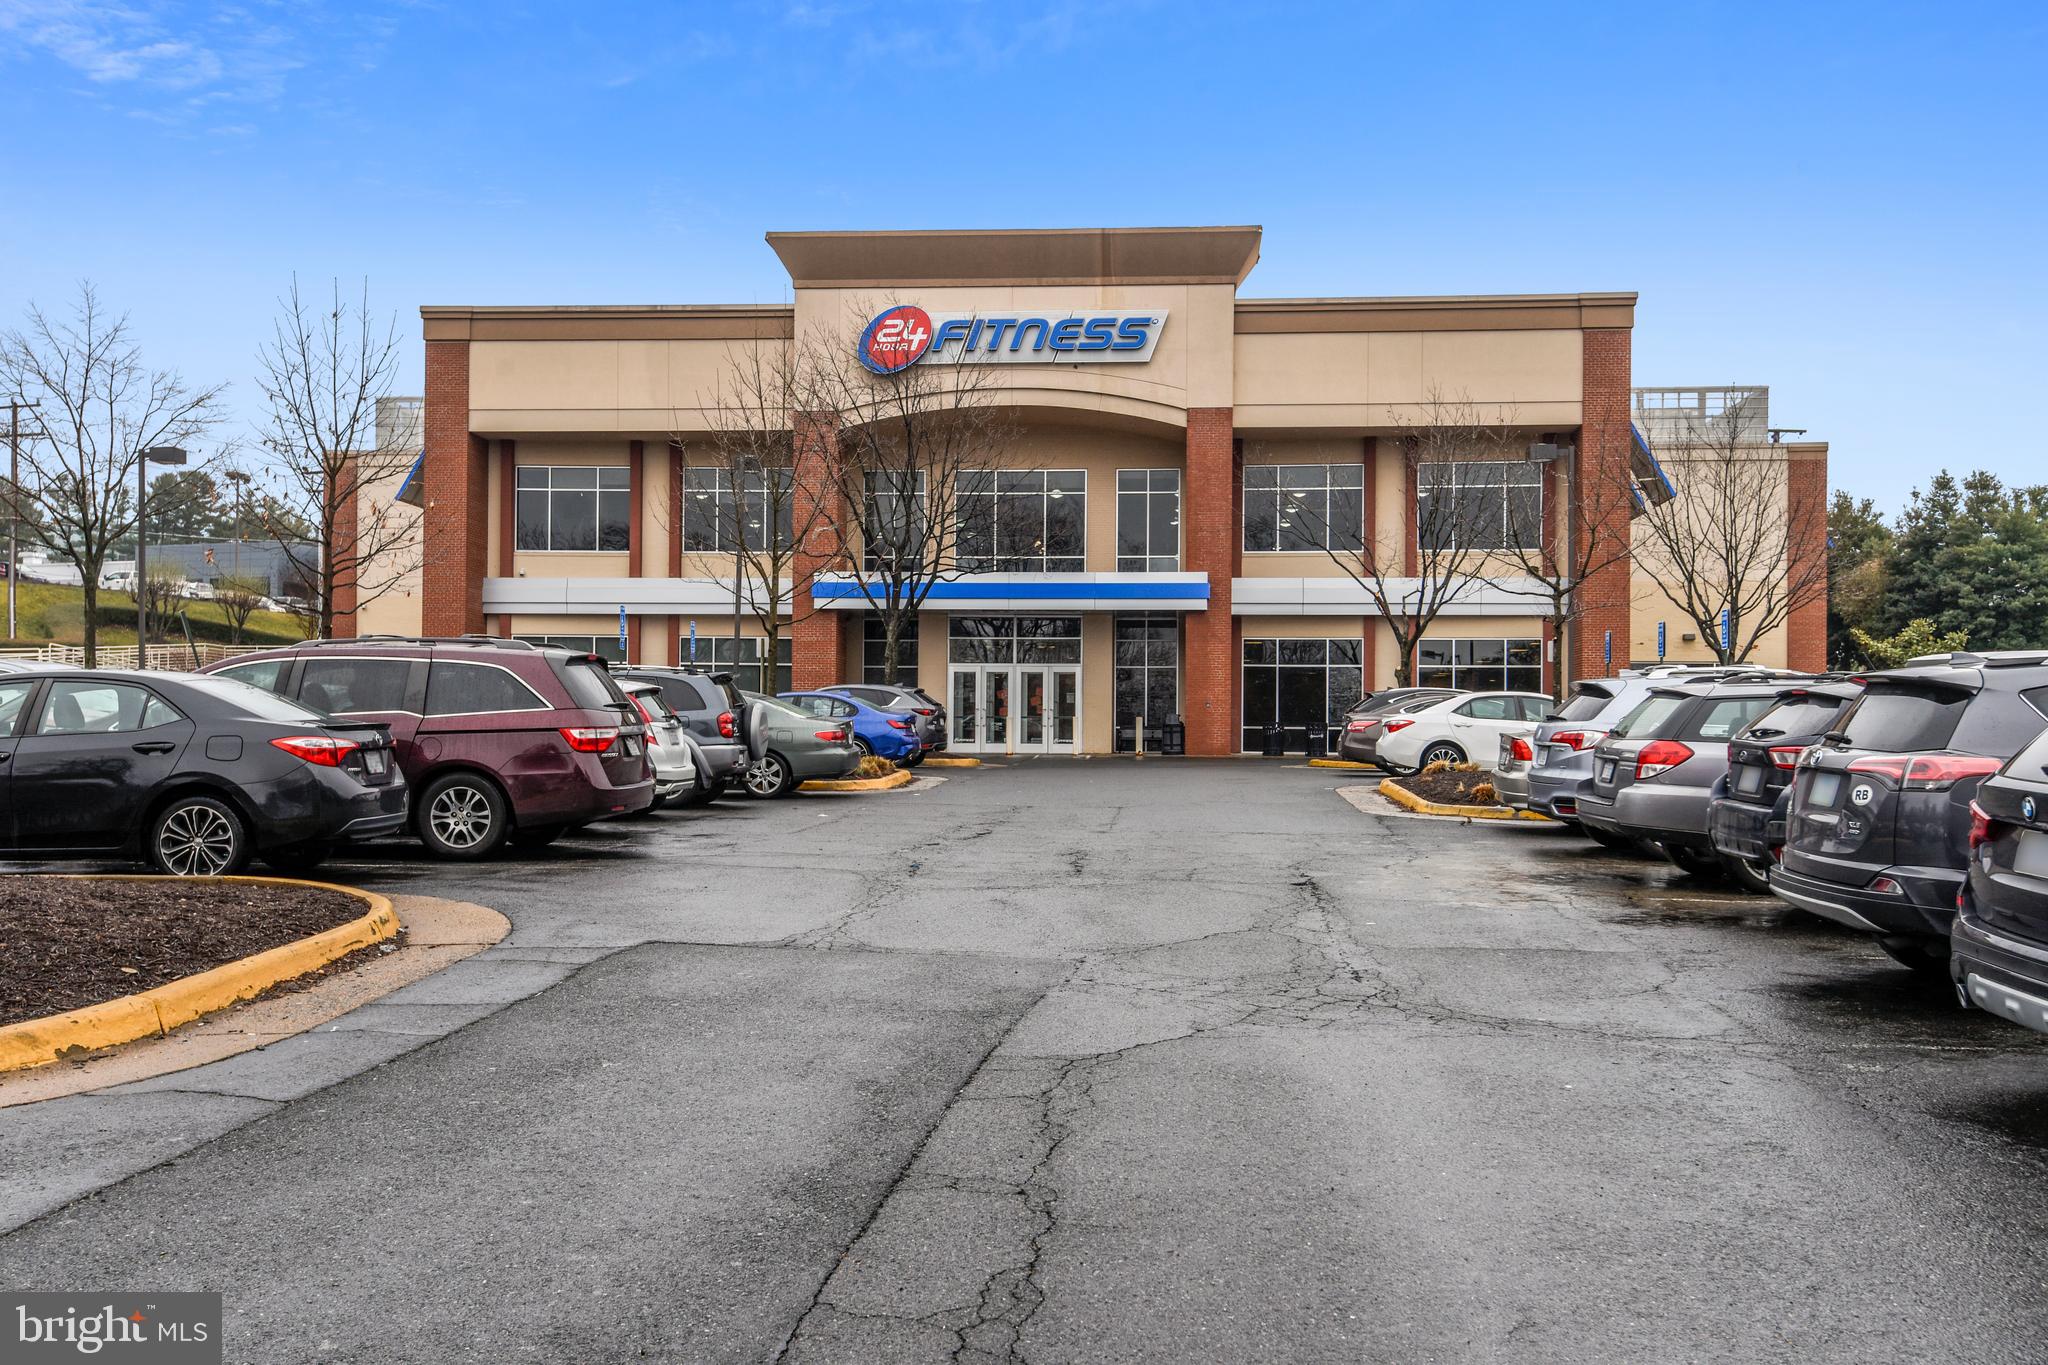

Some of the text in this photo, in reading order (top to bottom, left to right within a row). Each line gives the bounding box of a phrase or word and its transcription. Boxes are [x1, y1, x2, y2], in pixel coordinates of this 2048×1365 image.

[877, 317, 1152, 352] 24 FITNESS
[872, 342, 909, 351] HOUR
[1855, 790, 1868, 801] RB
